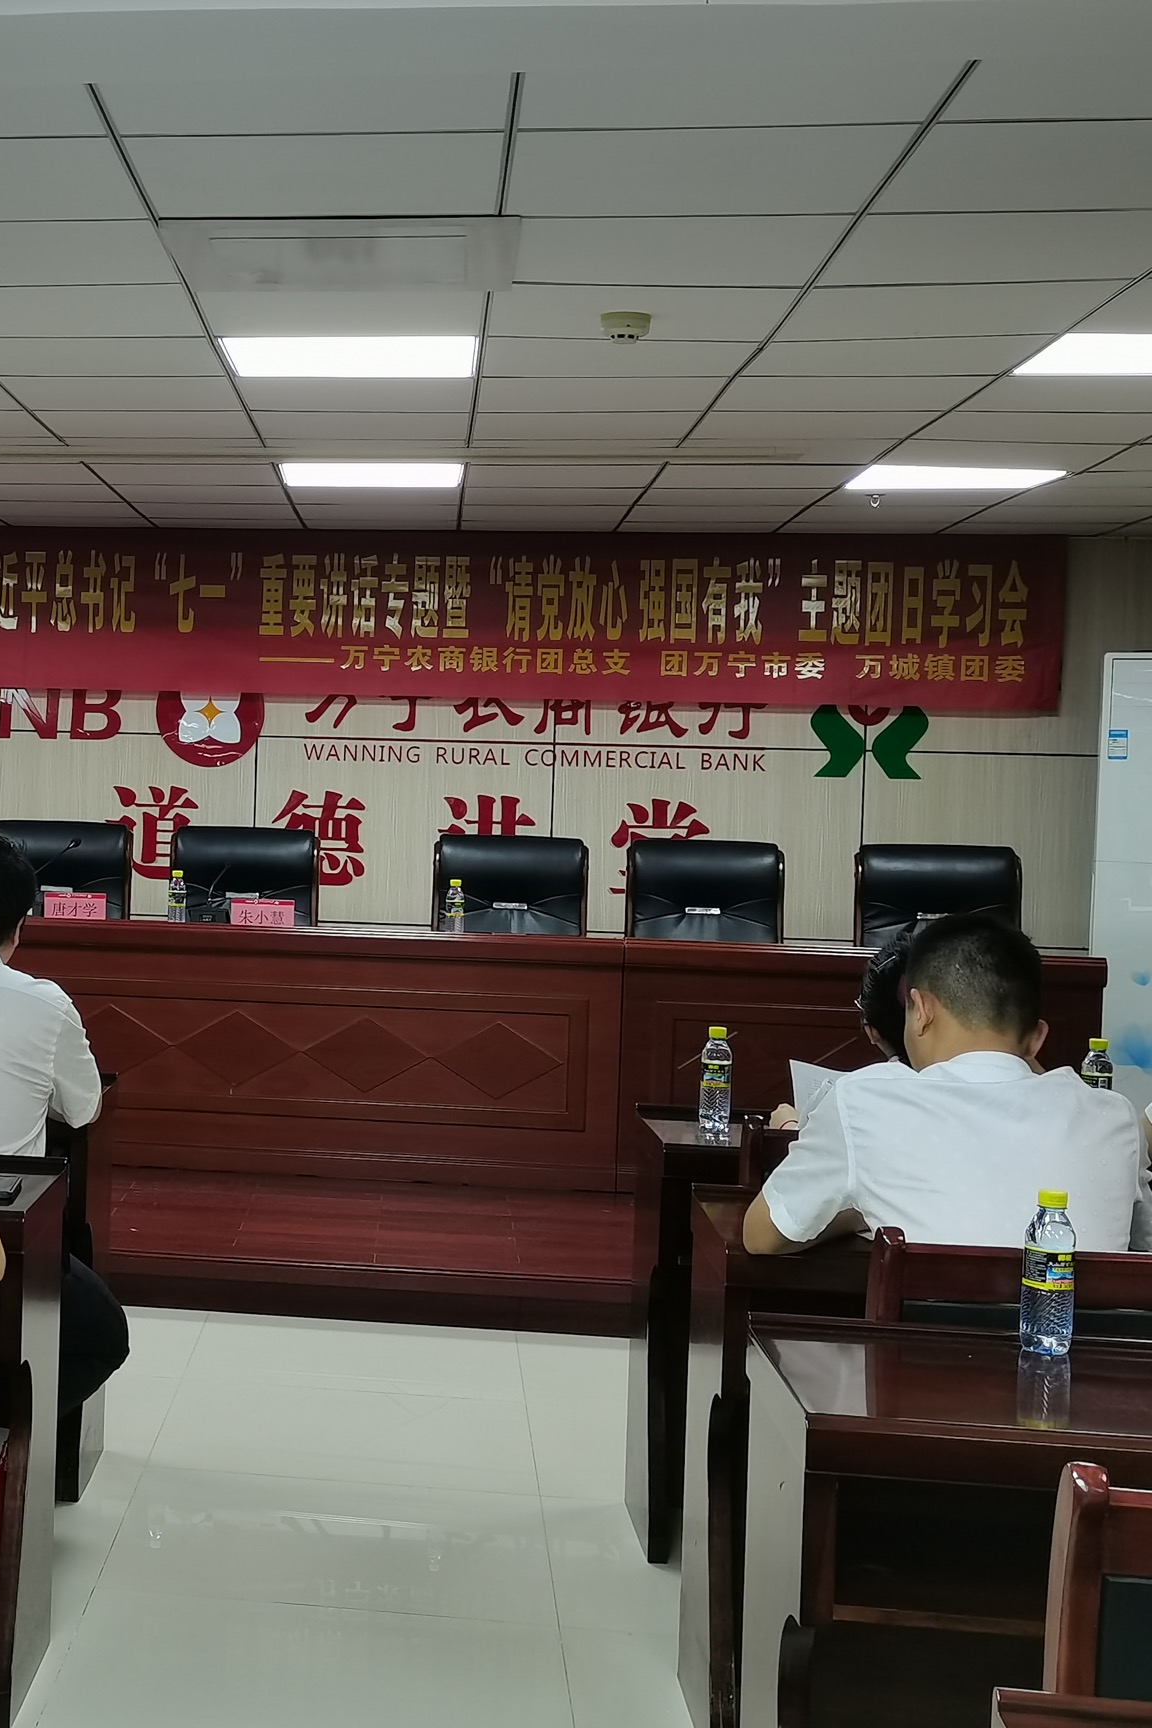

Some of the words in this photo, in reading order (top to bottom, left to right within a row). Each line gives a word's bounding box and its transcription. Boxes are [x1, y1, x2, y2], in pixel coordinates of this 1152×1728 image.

[660, 650, 826, 680] 团万宁市委
[855, 652, 1026, 683] 万城镇团委
[304, 743, 420, 763] WANNING
[436, 746, 510, 765] RURAL
[525, 749, 686, 769] COMMERCIAL
[701, 752, 766, 772] BANK
